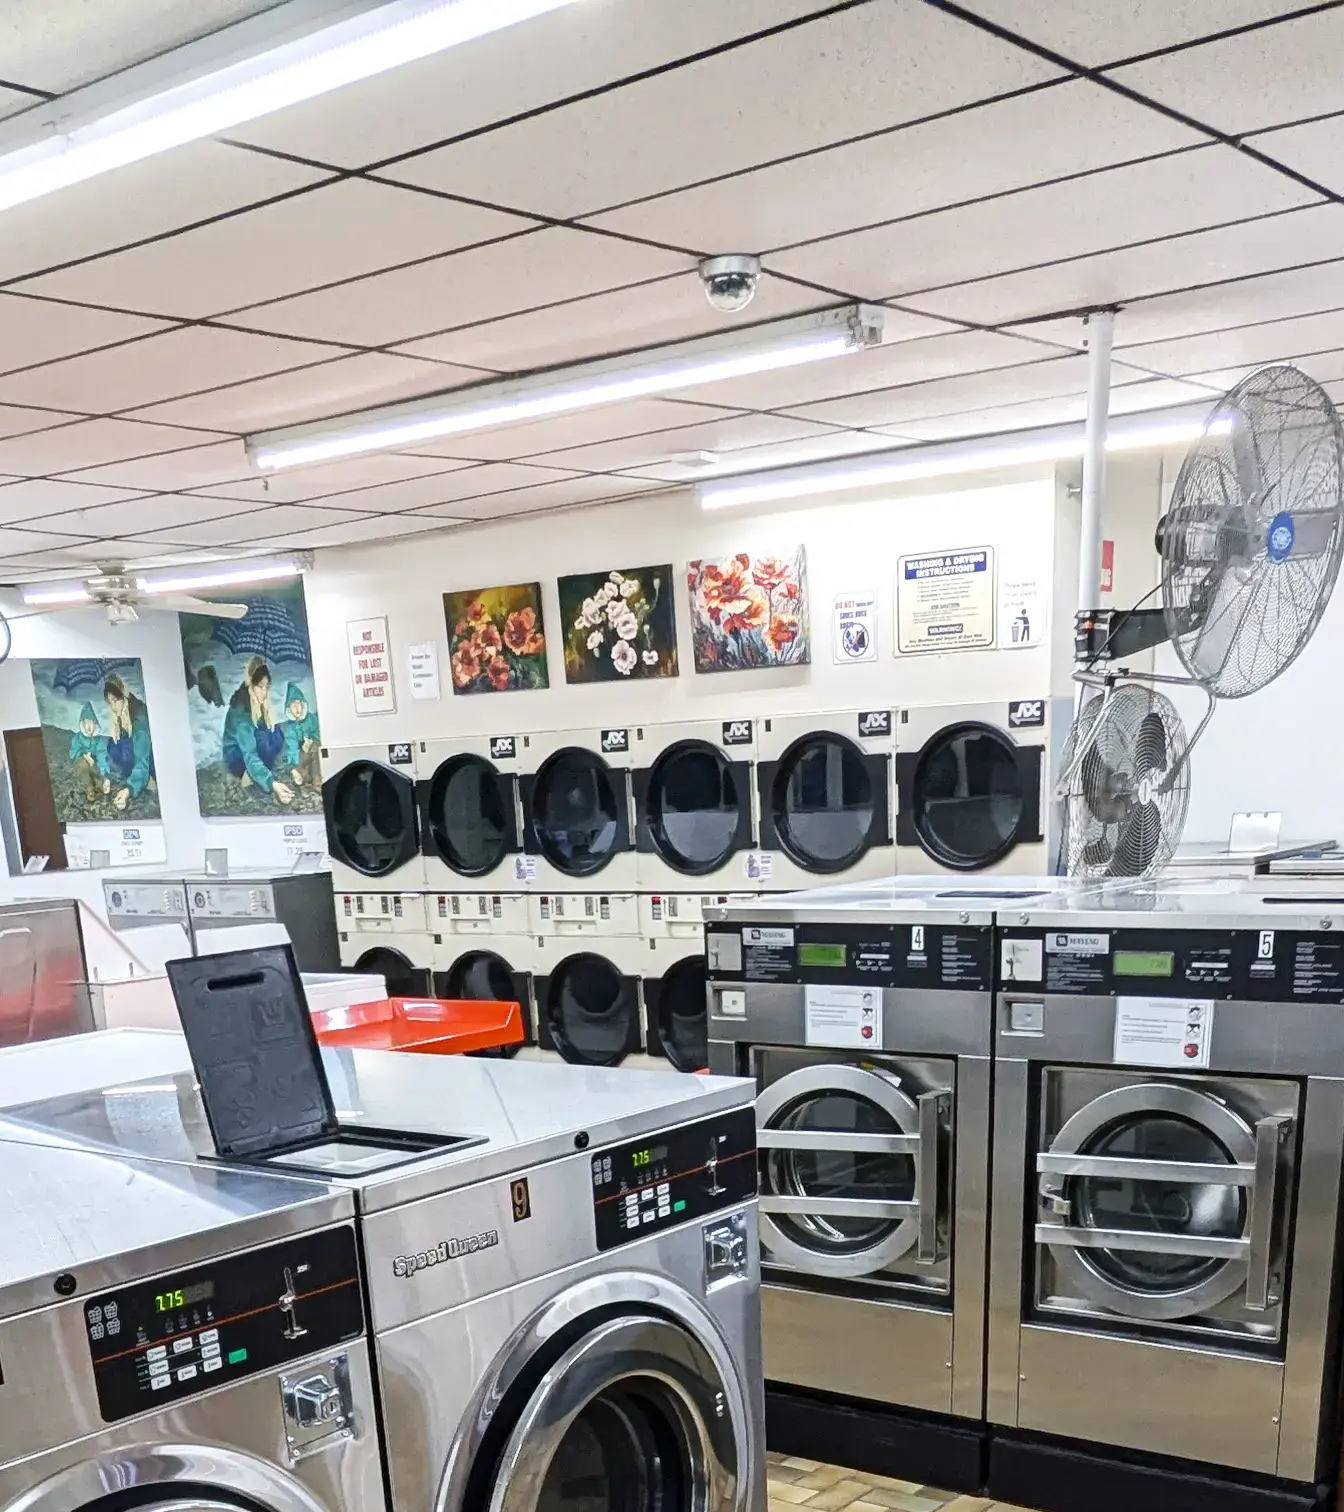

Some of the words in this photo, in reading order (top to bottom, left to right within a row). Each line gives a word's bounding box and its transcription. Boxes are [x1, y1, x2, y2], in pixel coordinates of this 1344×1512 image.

[916, 564, 975, 578] INSTRUCTIONS
[353, 643, 385, 655] RESPONSIBLE
[913, 928, 923, 948] 4
[1261, 933, 1273, 957] 5
[512, 1180, 530, 1219] 9
[393, 1241, 448, 1278] Speed
[447, 1230, 498, 1259] Queen
